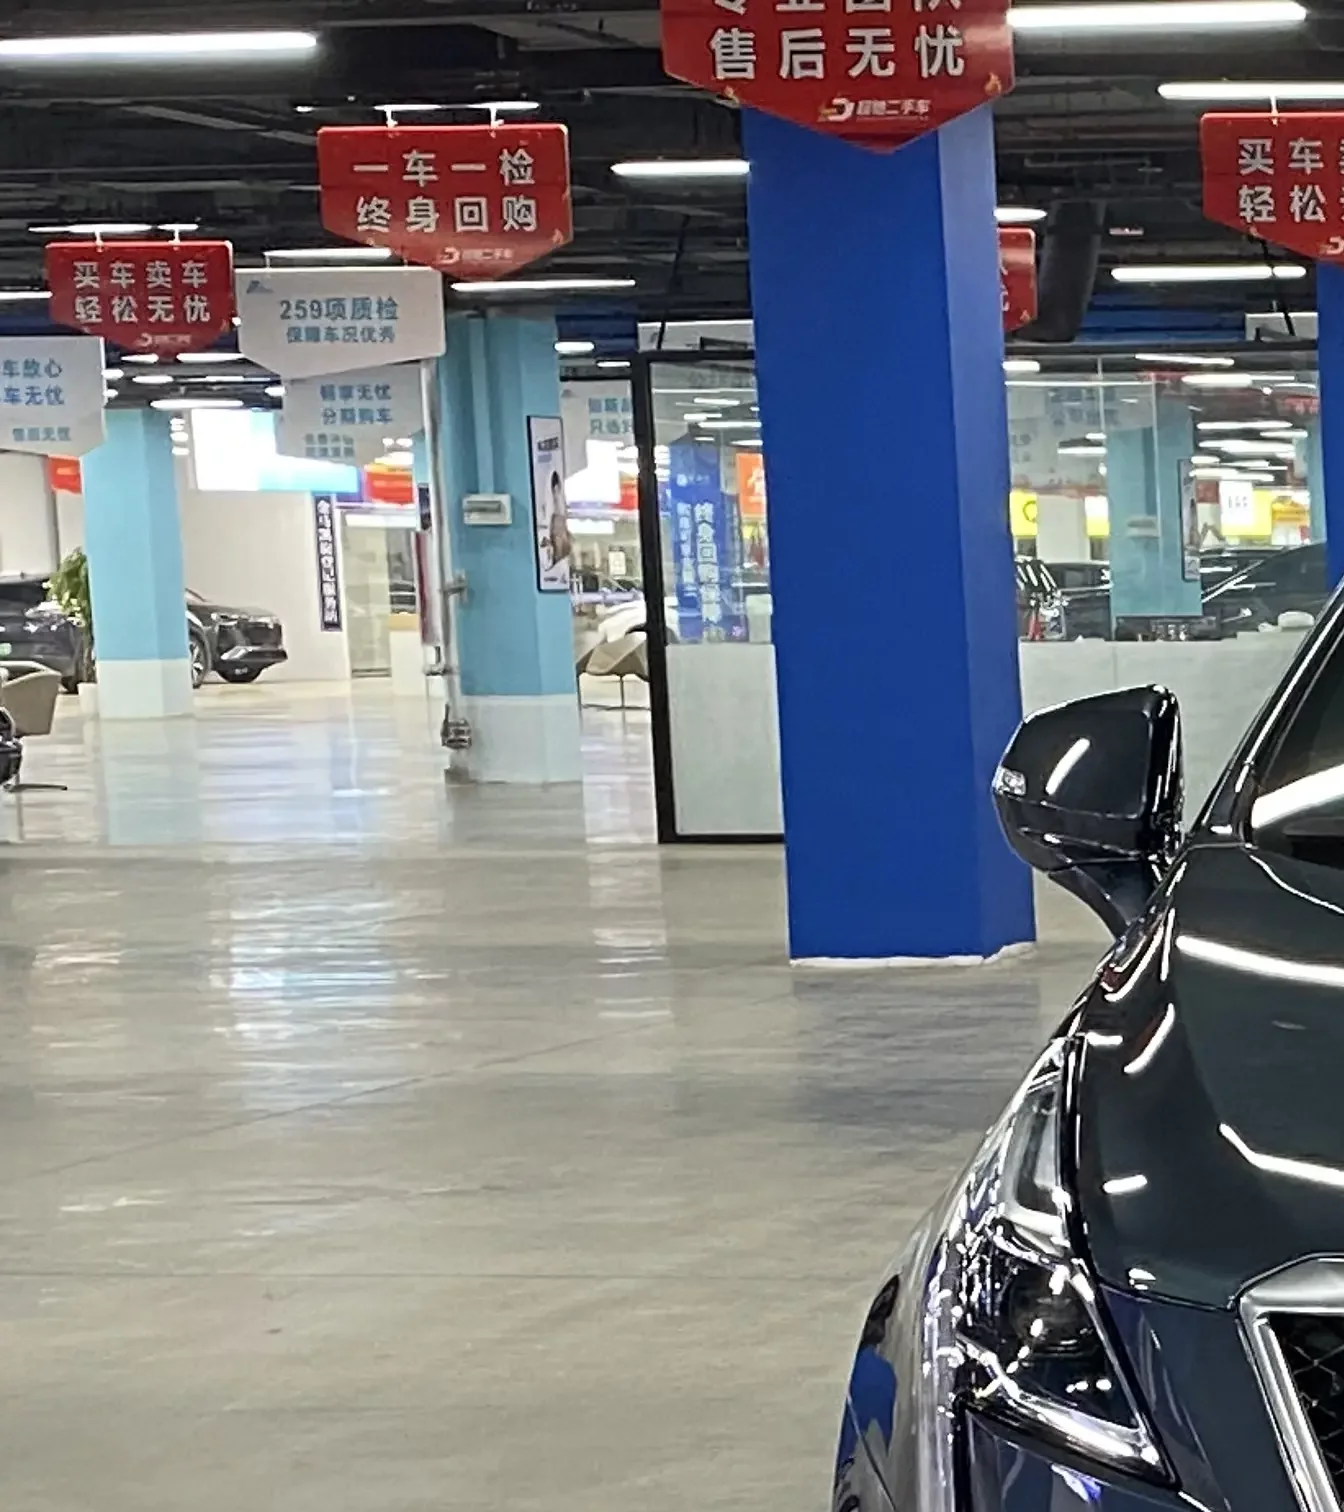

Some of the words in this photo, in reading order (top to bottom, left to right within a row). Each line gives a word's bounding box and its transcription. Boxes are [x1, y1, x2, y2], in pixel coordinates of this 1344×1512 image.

[709, 25, 965, 80] 售后无忧
[353, 148, 536, 187] 一车一检
[356, 194, 537, 233] 终身回购
[73, 260, 208, 289] 买车卖车
[74, 296, 211, 323] 轻松无忧
[279, 296, 399, 322] 259项质检
